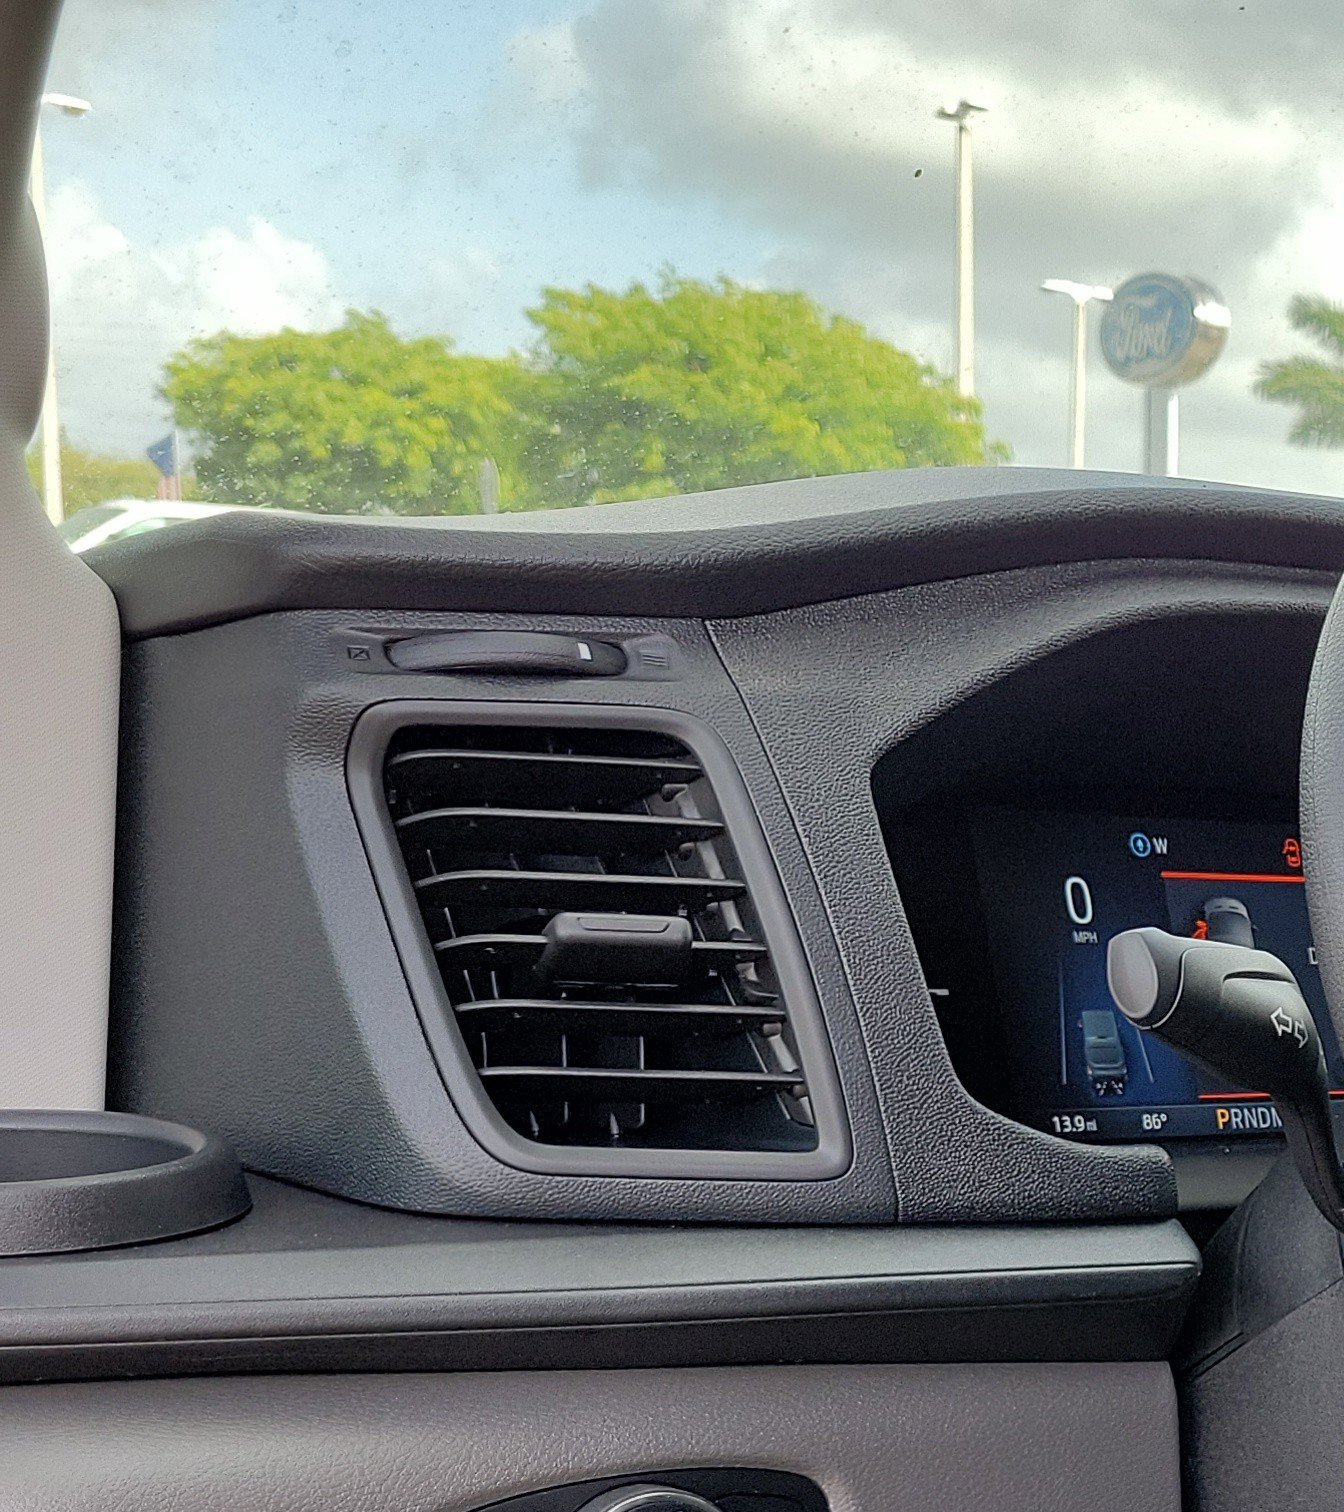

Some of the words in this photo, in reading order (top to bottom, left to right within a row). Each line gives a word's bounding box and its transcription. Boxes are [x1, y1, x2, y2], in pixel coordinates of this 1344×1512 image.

[1152, 837, 1168, 855] W
[1064, 876, 1093, 925] 0
[1073, 930, 1098, 945] MPH
